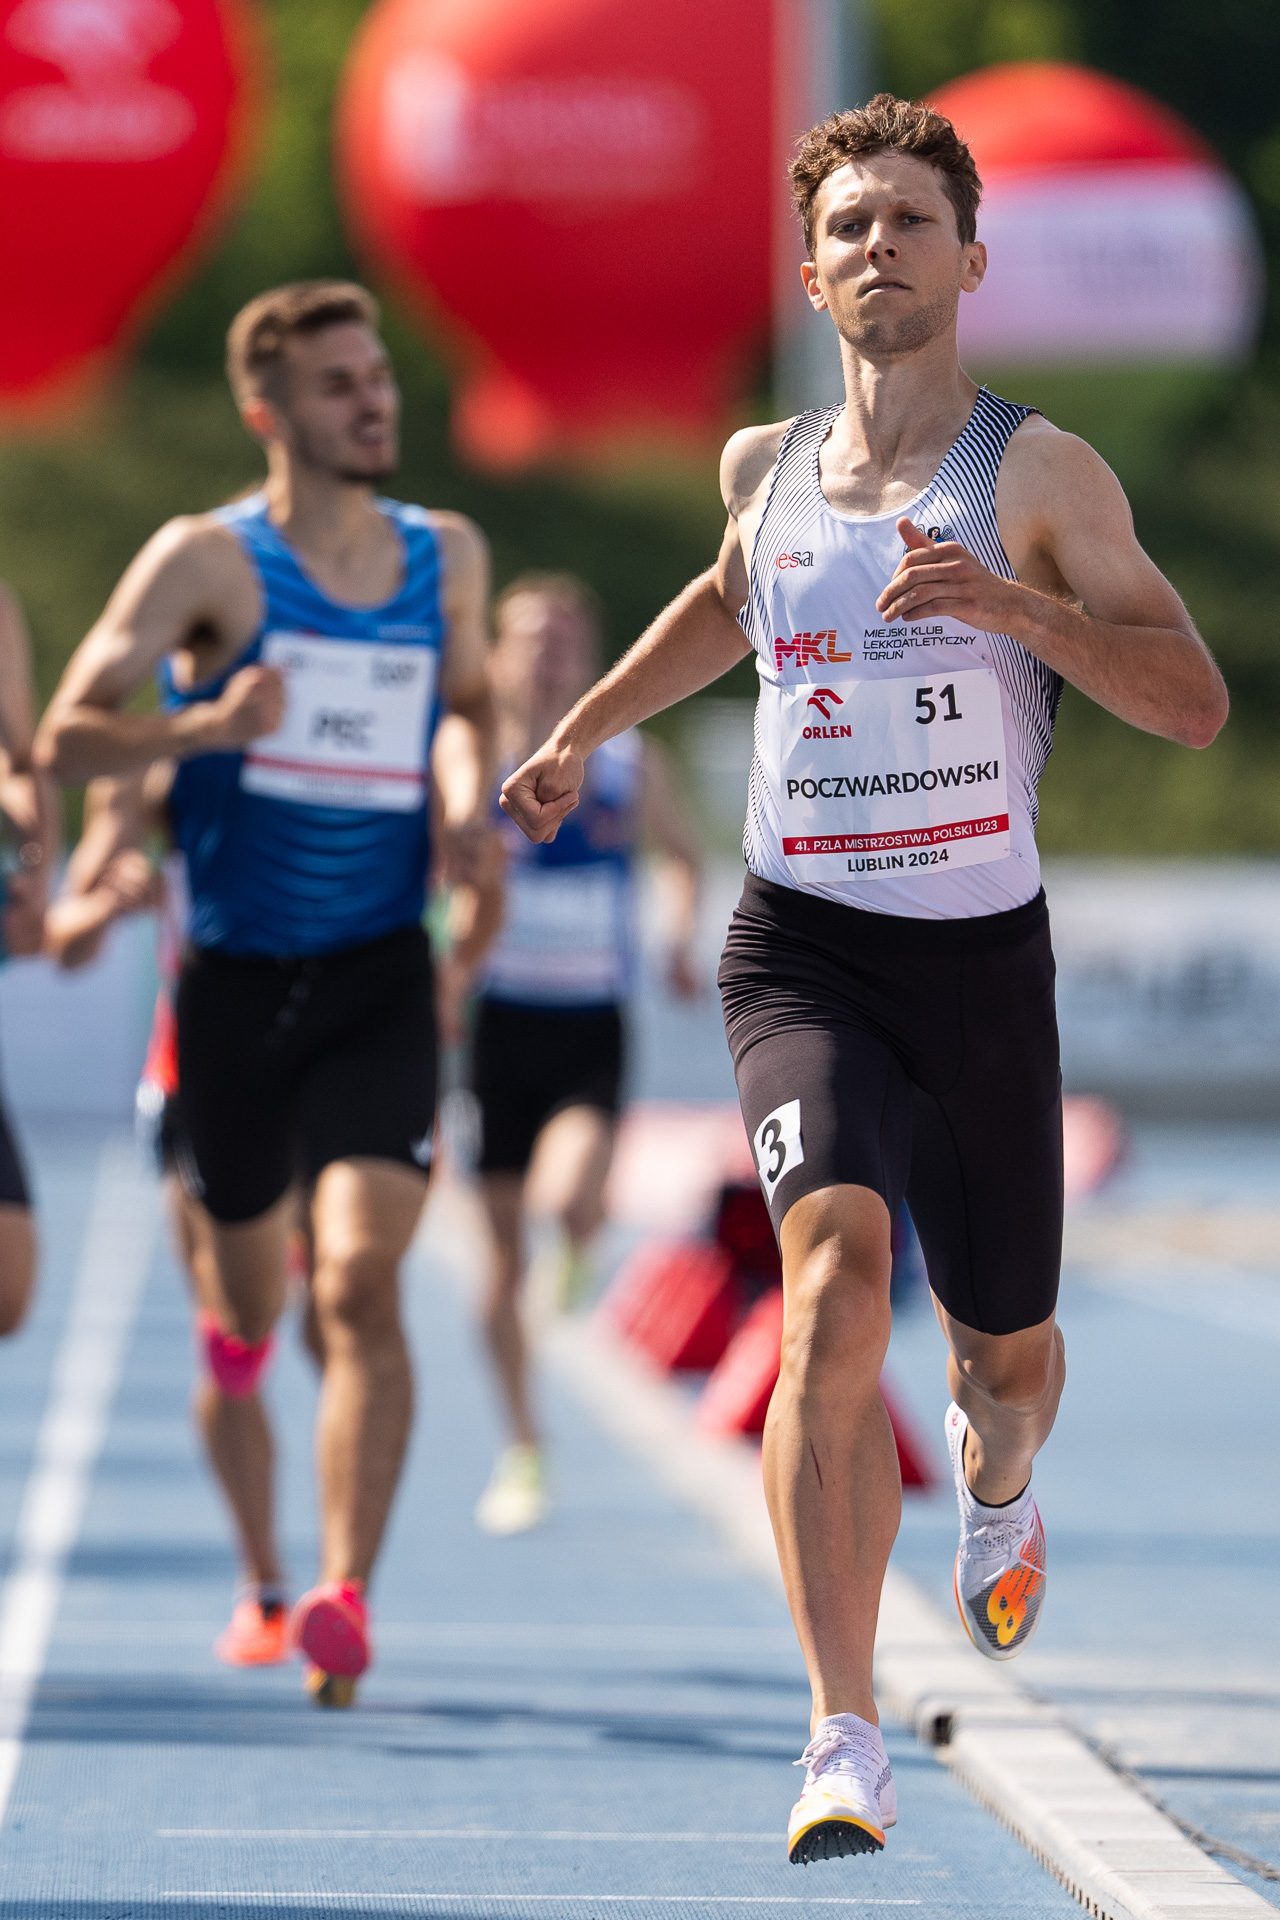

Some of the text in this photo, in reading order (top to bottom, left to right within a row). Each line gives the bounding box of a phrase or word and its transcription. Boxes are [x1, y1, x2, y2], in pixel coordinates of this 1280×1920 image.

[863, 636, 977, 649] LEKKOATLETYCZNY
[864, 625, 943, 638] MIEJSKI KLUB
[774, 629, 852, 671] MKL
[862, 649, 904, 660] TORUŃ
[915, 683, 963, 725] 51
[802, 724, 852, 740] ORLEN
[786, 760, 1000, 800] POCZWARDOWSKI
[794, 819, 998, 851] 41. PZLA MISTRZOSTWA POLSKI U23
[847, 848, 949, 873] LUBLIN 2024
[761, 1118, 787, 1183] 3
